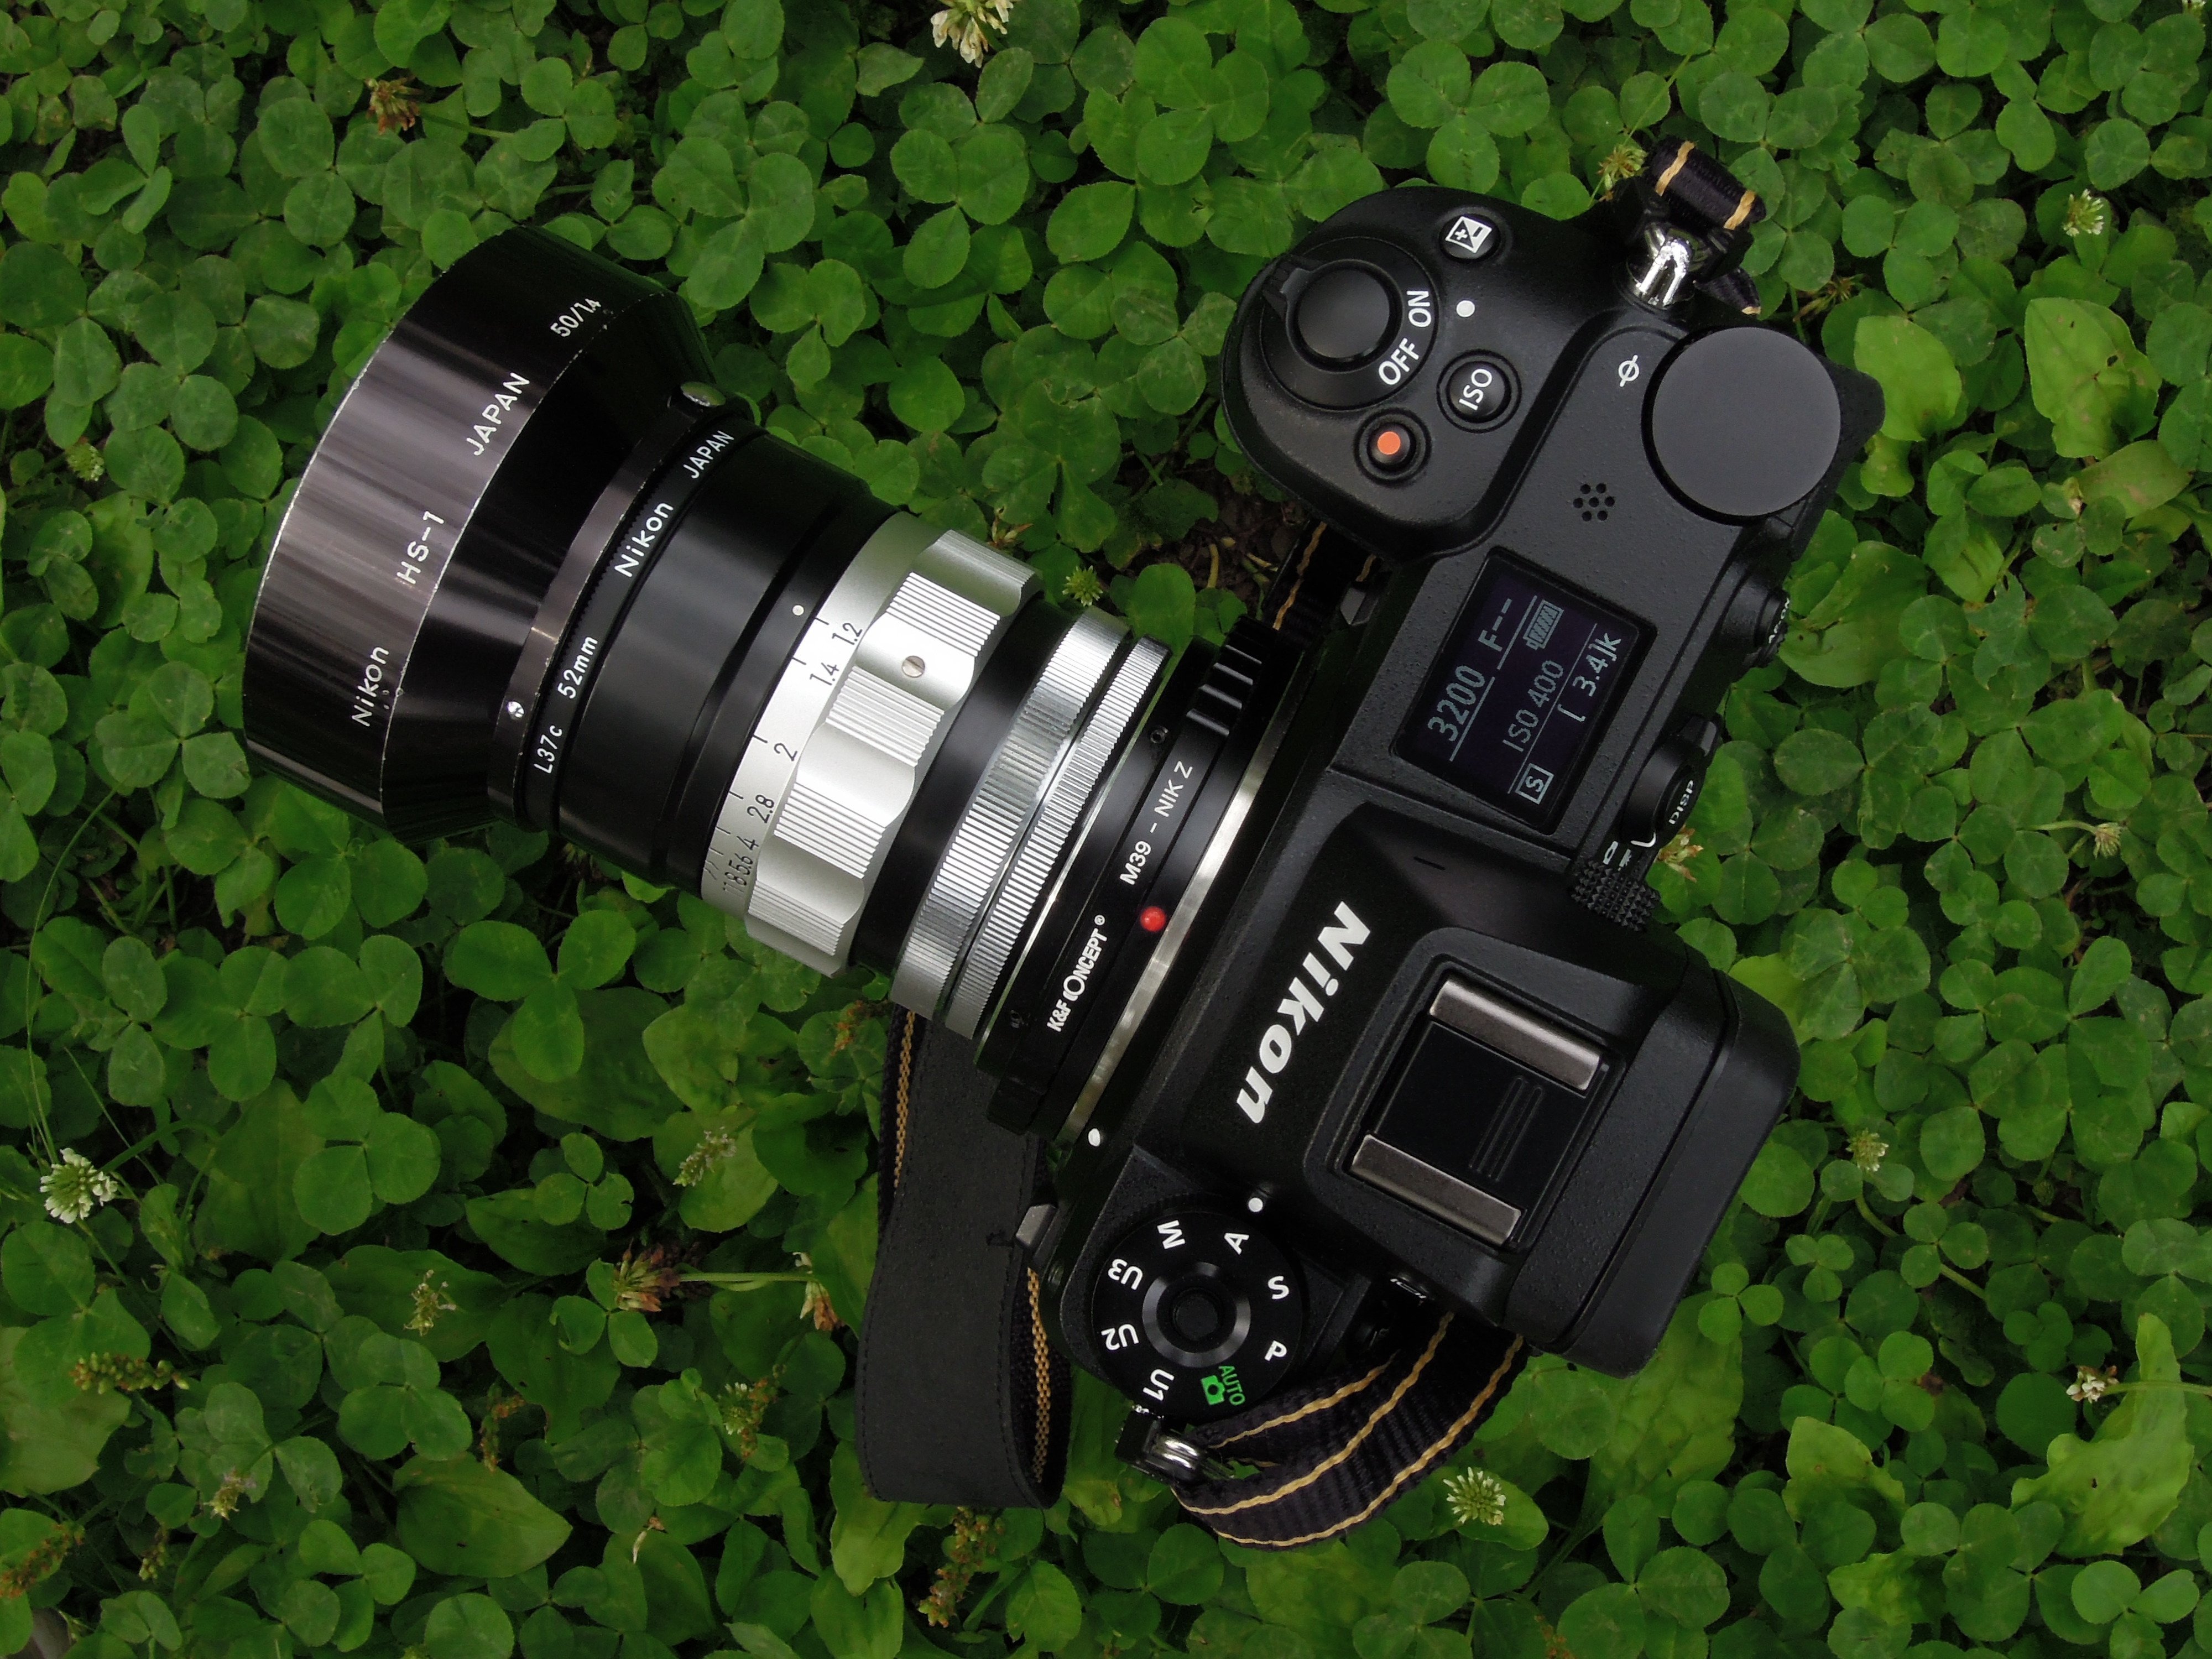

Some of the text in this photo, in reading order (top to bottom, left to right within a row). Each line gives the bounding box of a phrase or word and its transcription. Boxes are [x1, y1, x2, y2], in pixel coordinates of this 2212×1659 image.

[1406, 290, 1432, 328] ON
[1379, 337, 1420, 385] OFF
[1458, 368, 1493, 410] ISO
[351, 646, 389, 727] Nikon
[397, 510, 444, 584] HS-1
[466, 372, 530, 456] JAPAN
[534, 431, 734, 774] L37c 52mm Nikon JAPAN
[832, 623, 862, 645] 1.2
[810, 663, 839, 686] 1.4
[1428, 665, 1485, 742] 3200
[1503, 660, 1564, 752] ISO 400
[774, 743, 797, 761] 2
[747, 795, 774, 824] 2.8
[1668, 780, 1693, 825] DISP
[1119, 841, 1151, 885] M39
[1154, 779, 1184, 818] NIK
[1173, 760, 1193, 779] Z
[736, 836, 759, 851] 4
[1047, 999, 1071, 1032] K&F
[1236, 901, 1371, 1124] Nikon
[1157, 1220, 1186, 1249] M
[1224, 1233, 1250, 1255] A
[1108, 1259, 1143, 1290] U3
[1267, 1276, 1290, 1300] S
[1101, 1324, 1139, 1350] U2
[1264, 1340, 1287, 1361] P
[1142, 1369, 1175, 1401] U1
[1219, 1365, 1245, 1405] AUTO
